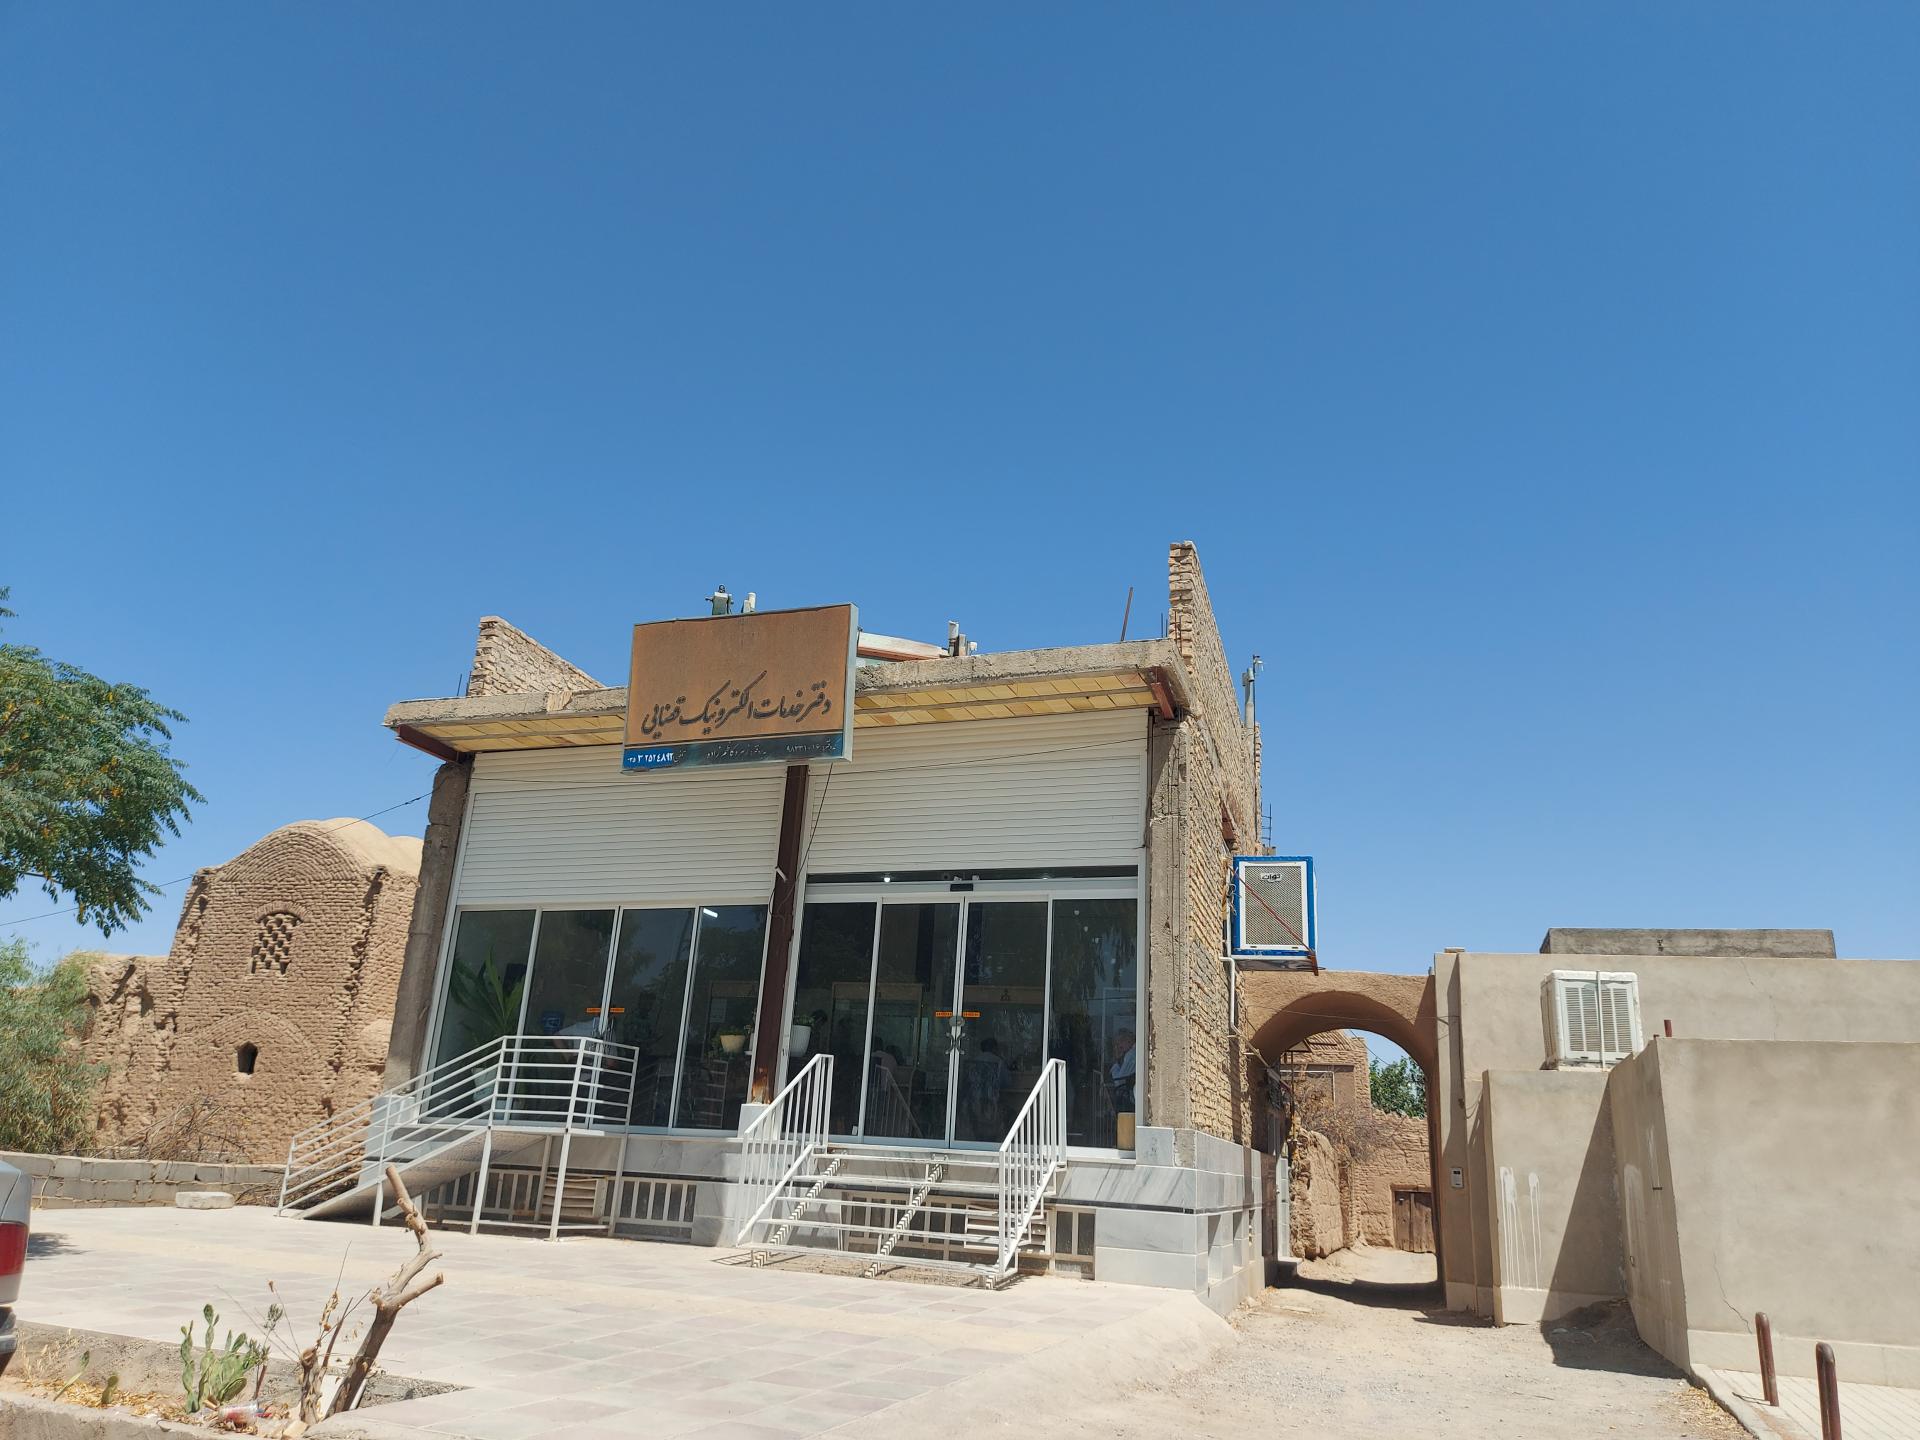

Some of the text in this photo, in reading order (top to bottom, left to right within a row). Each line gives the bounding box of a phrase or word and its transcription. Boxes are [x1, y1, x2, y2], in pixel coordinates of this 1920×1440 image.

[679, 669, 768, 736] الکترونیک
[752, 689, 806, 719] خدمات
[795, 680, 833, 723] دفتر
